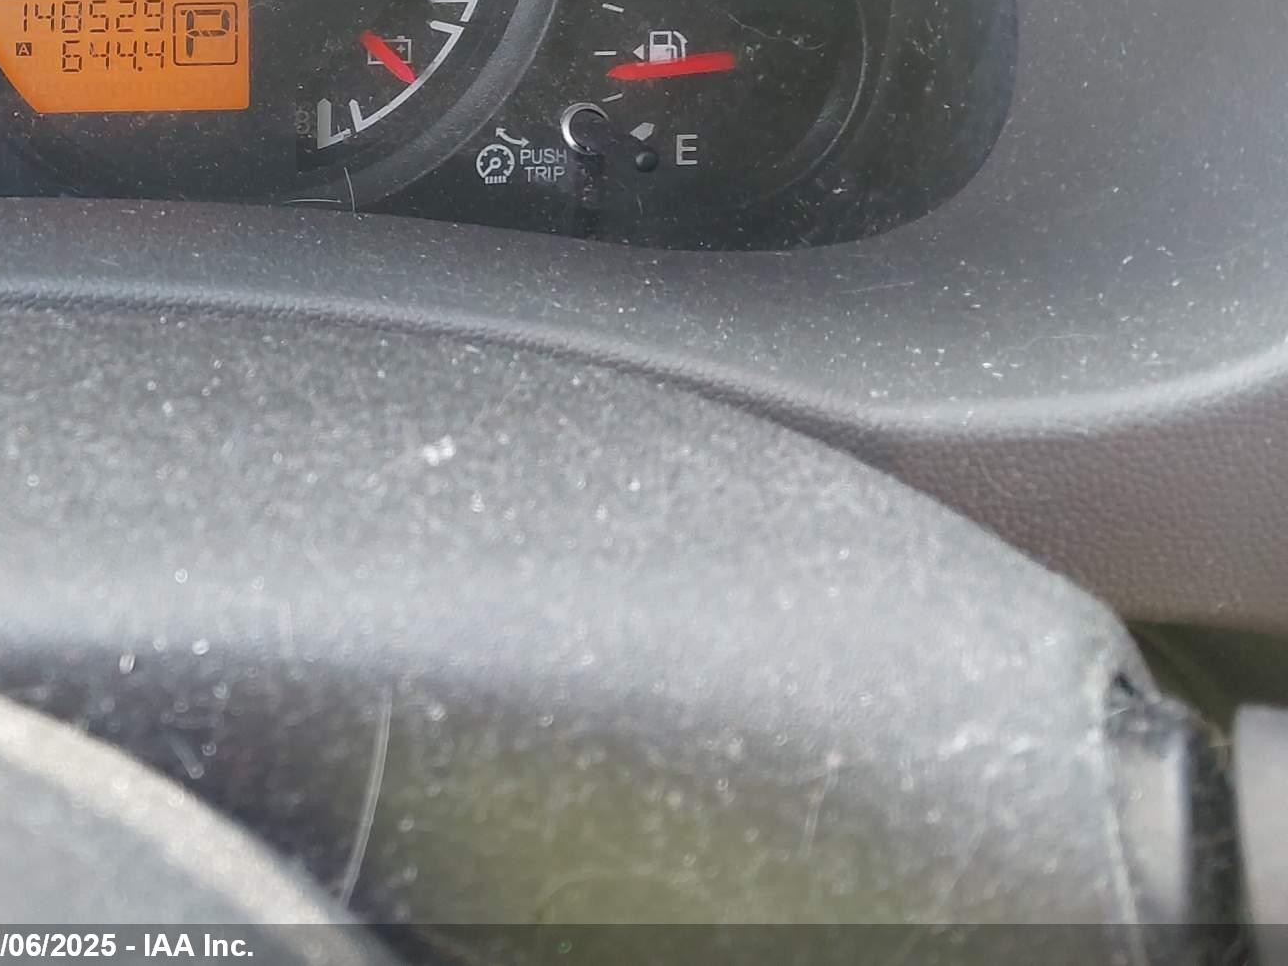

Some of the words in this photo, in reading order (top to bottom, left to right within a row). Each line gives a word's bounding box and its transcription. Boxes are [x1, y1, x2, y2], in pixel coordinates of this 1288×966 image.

[22, 0, 165, 34] 148529
[180, 9, 230, 58] P
[62, 40, 165, 73] 644.4
[519, 148, 568, 166] PUSH
[676, 134, 698, 165] E
[523, 165, 566, 183] TRIP
